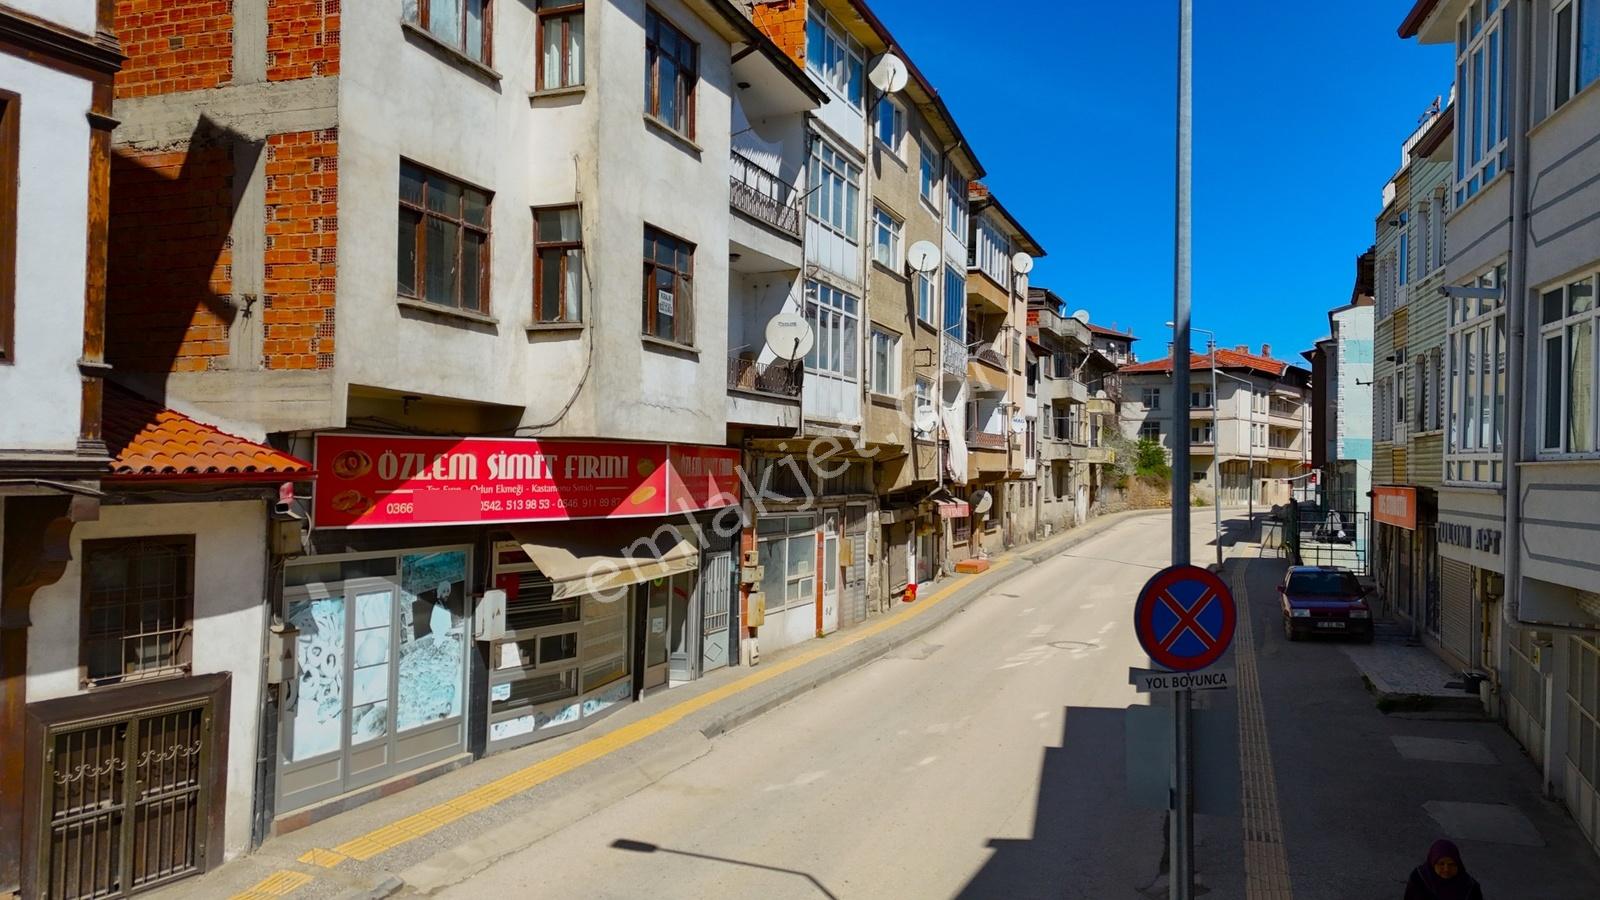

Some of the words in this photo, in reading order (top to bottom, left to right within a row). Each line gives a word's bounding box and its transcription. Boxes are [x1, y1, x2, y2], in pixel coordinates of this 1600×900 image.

[377, 450, 478, 481] ÖZLEM
[486, 450, 558, 480] SİMİT
[564, 455, 629, 479] FIRINI
[495, 484, 523, 496] Ekmeği
[386, 502, 414, 514] 0366
[505, 499, 524, 511] 513
[525, 499, 537, 510] 98
[538, 498, 551, 510] 53
[1145, 676, 1169, 690] YOL
[1171, 673, 1228, 688] BOYUNCA
